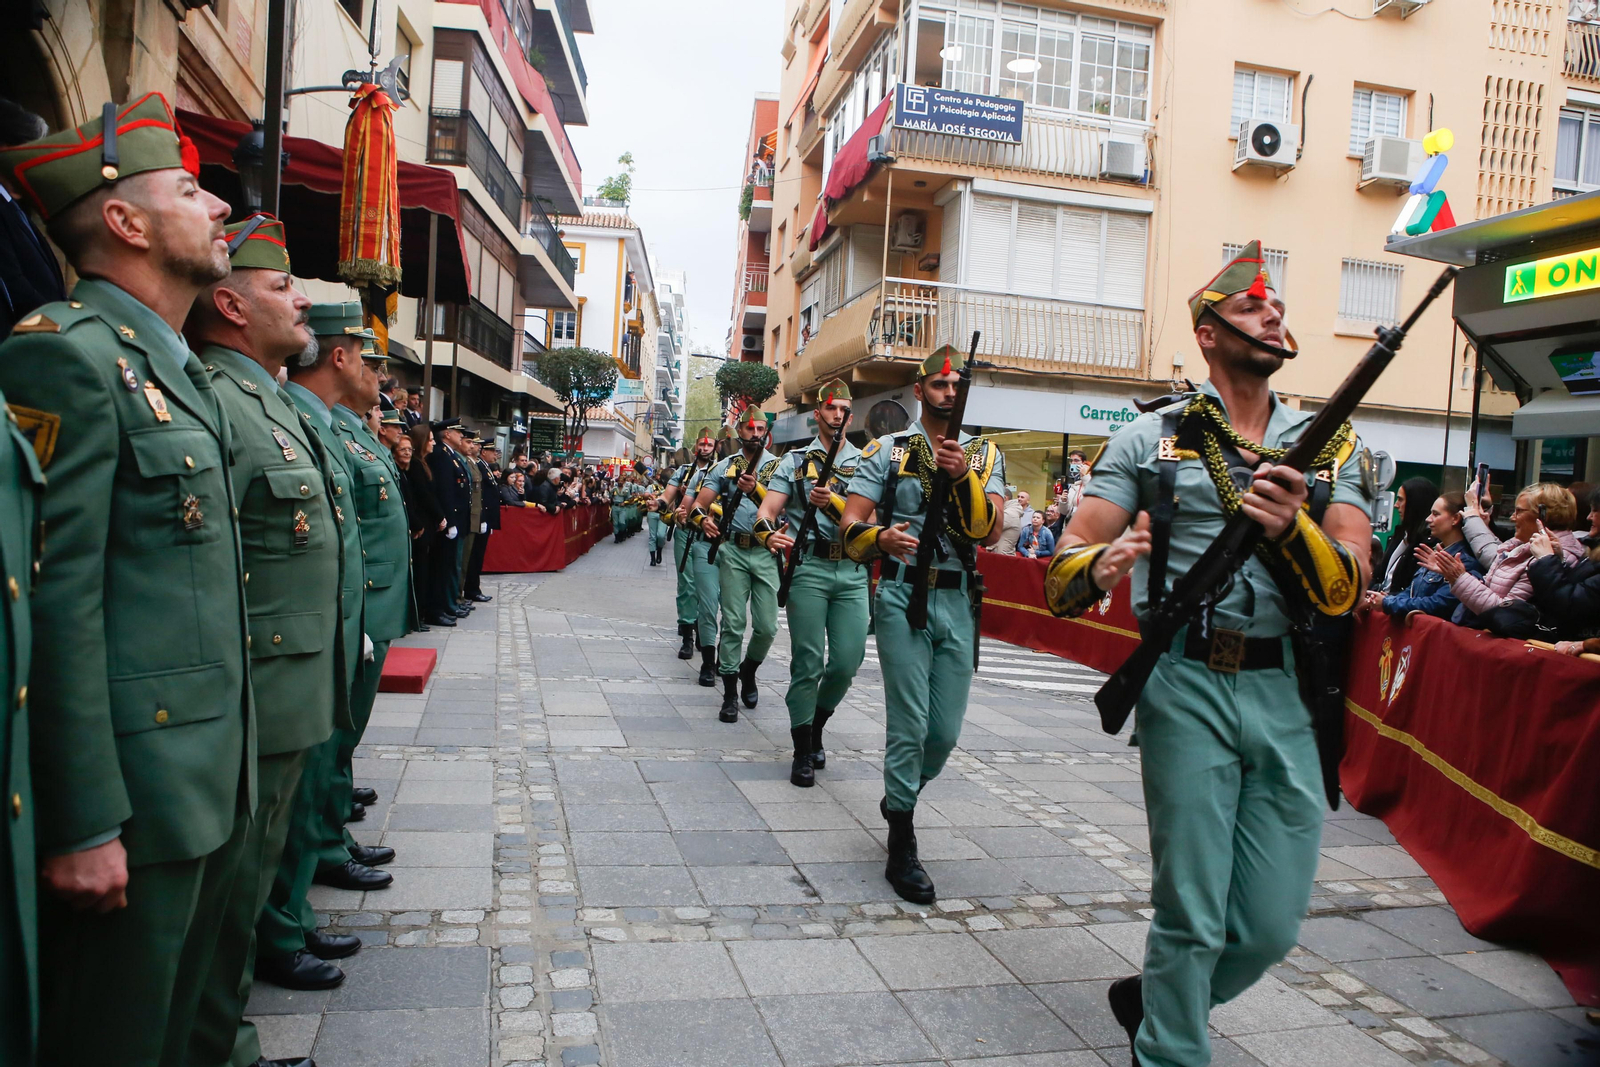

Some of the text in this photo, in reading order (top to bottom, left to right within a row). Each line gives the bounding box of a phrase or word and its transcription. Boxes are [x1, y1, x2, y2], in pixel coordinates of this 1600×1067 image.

[933, 104, 1016, 123] y Psicología Aplicada
[934, 92, 1016, 113] Centro de Pedagogía
[903, 118, 1015, 142] MARÍA JOSÉ SEGOVIA
[1548, 255, 1597, 287] ON
